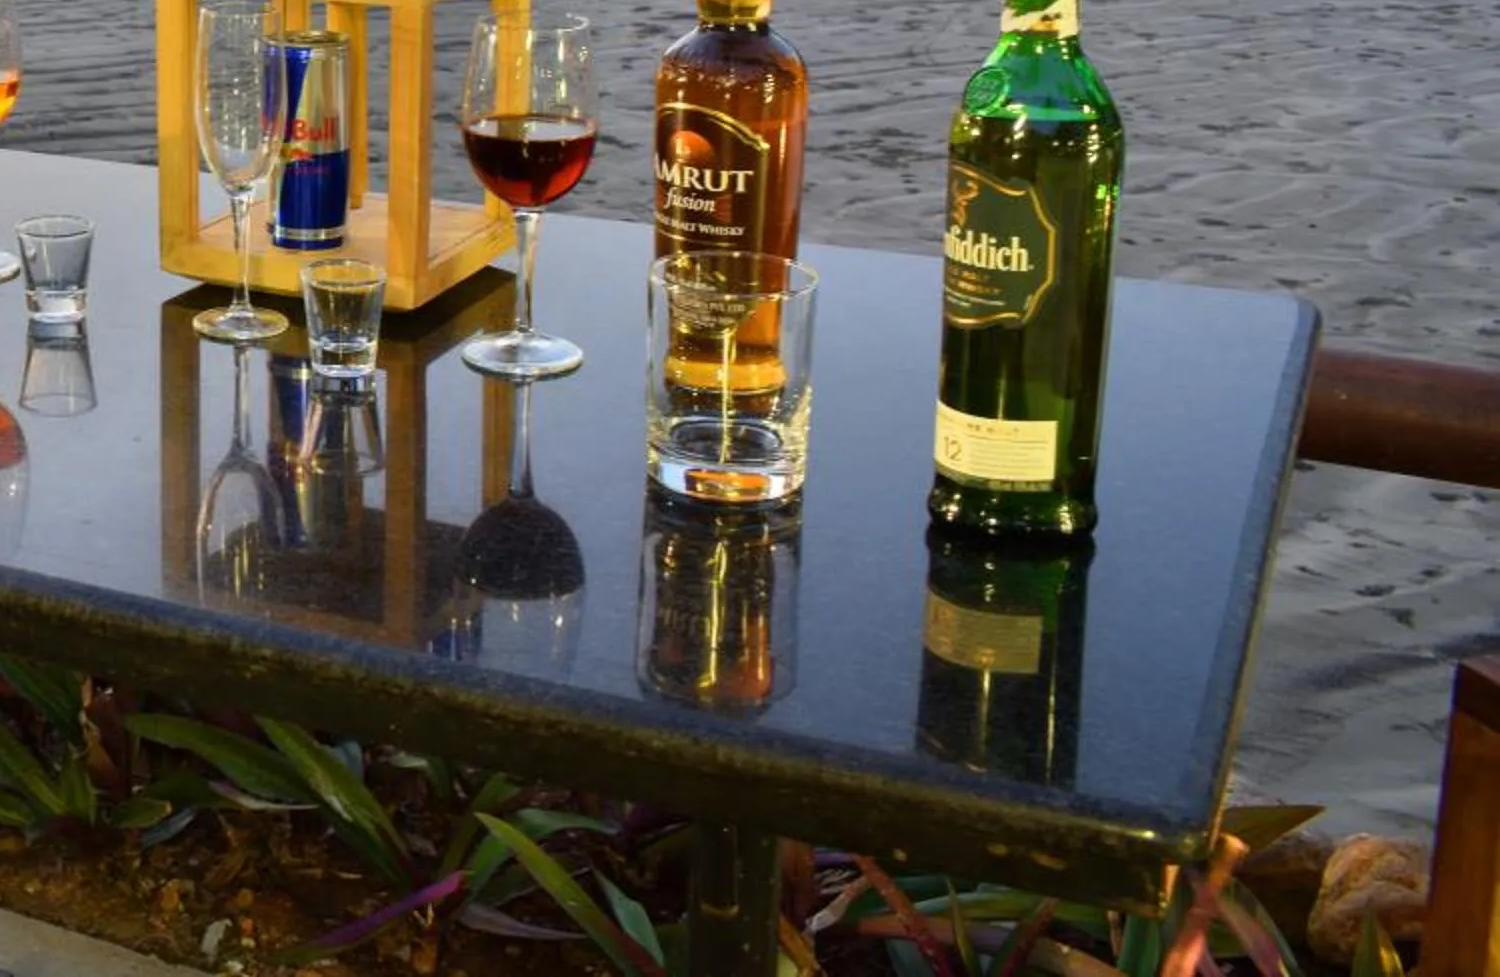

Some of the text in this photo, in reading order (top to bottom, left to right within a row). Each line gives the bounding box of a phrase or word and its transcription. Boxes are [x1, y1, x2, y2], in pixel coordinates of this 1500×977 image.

[292, 117, 335, 140] Bull
[664, 187, 717, 212] fusion
[944, 436, 962, 461] 12
